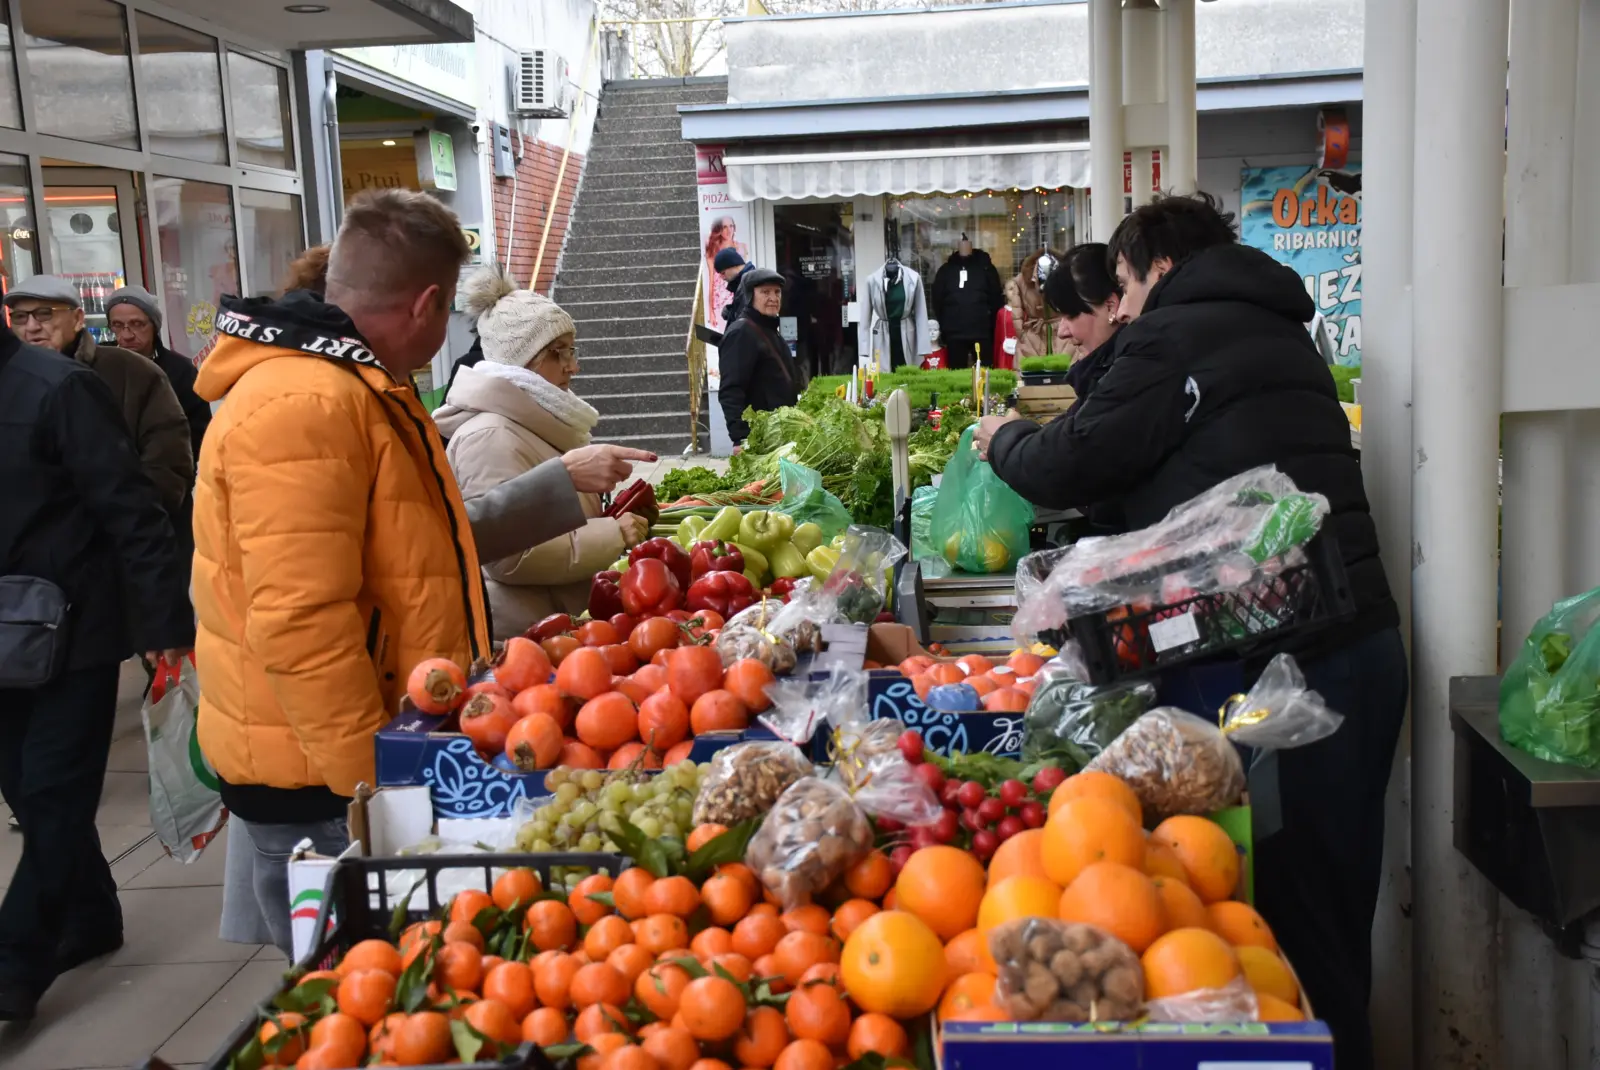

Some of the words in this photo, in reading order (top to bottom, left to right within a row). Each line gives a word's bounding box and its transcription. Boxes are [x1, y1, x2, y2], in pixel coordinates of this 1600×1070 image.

[703, 192, 730, 203] PIDŽA
[1272, 184, 1358, 228] Orka
[1274, 230, 1360, 251] RIBARNIC
[217, 313, 283, 343] SPOR
[302, 336, 377, 364] ORT
